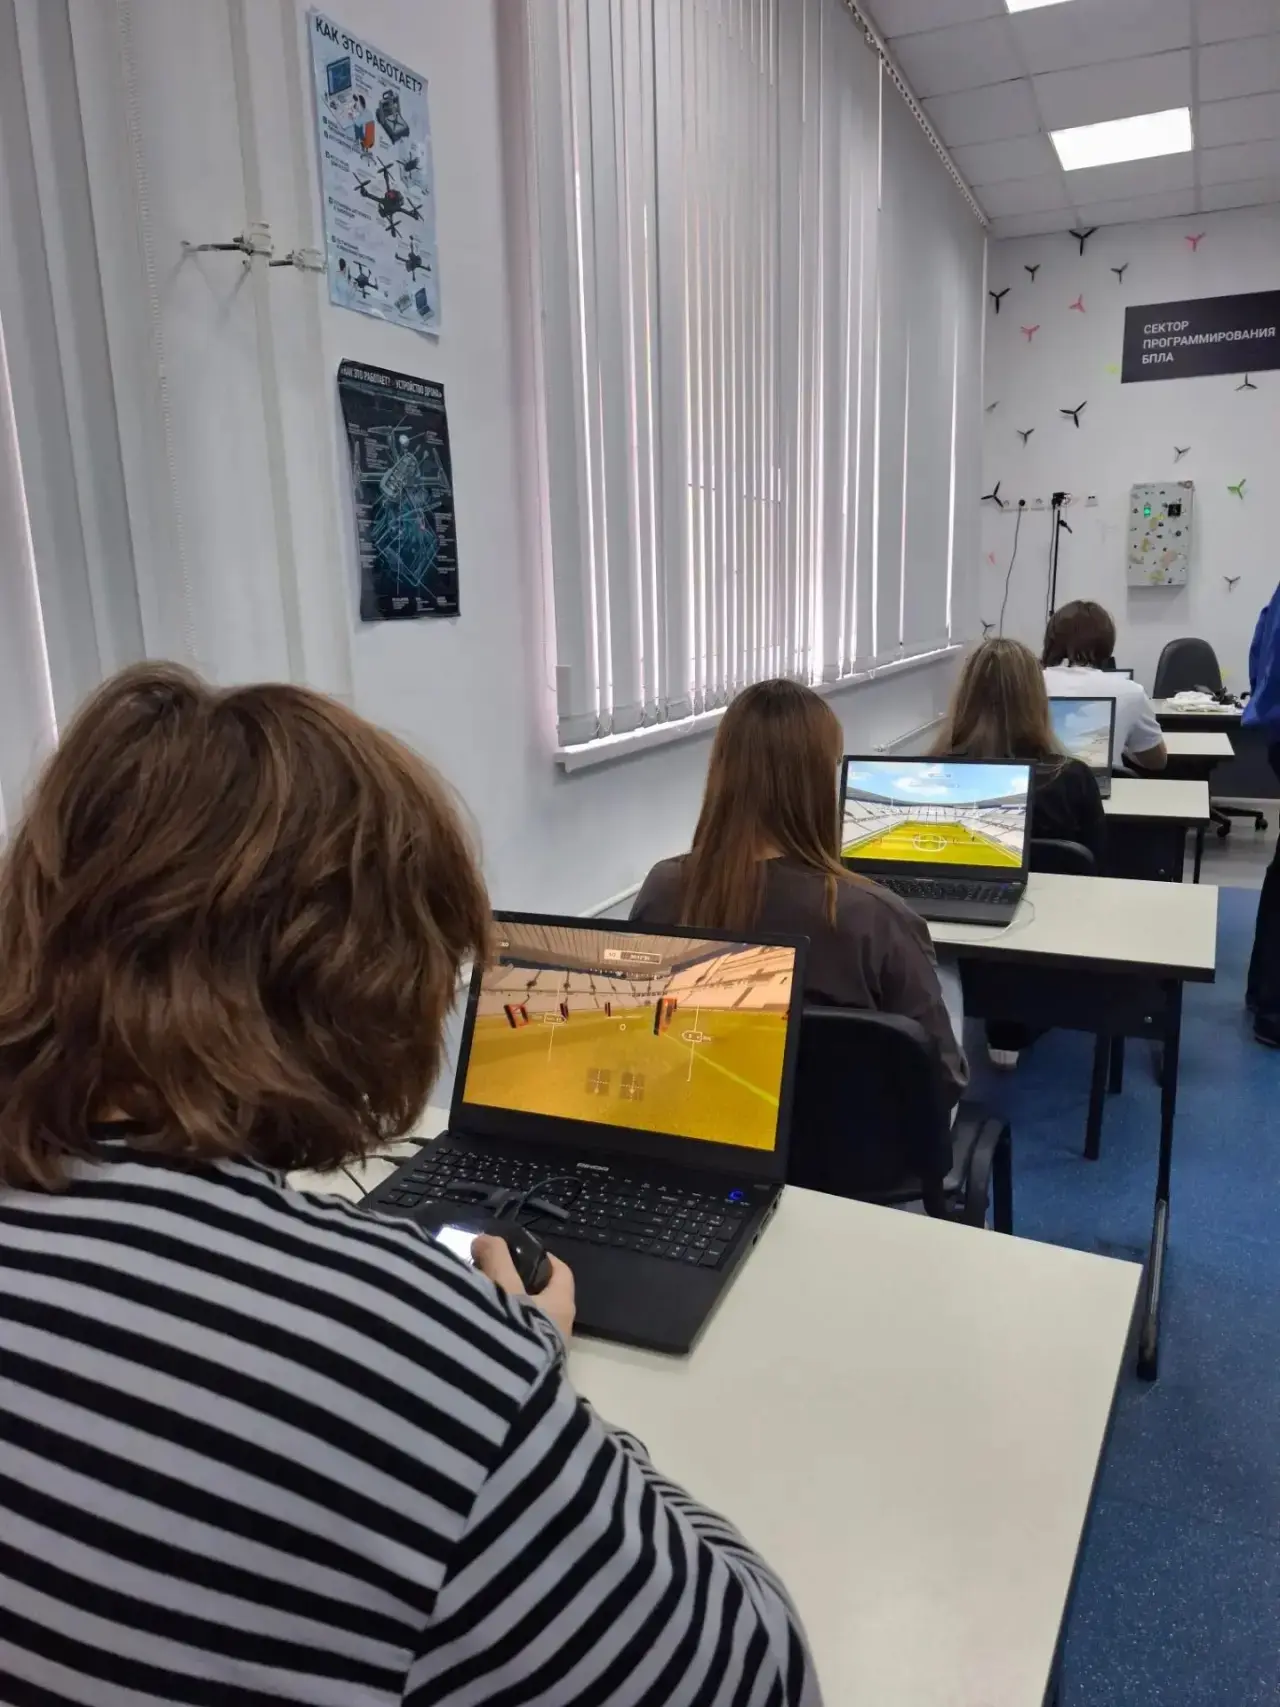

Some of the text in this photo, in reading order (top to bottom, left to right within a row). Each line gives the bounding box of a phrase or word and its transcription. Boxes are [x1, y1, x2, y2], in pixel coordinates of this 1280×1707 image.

[316, 16, 339, 44] КАК
[342, 34, 363, 59] ЭТО
[365, 50, 423, 96] РАБОТАЕТ?
[1144, 320, 1189, 334] СЕКТОР
[1142, 327, 1276, 349] ПРОГРАММИРОВАНИЯ
[1142, 352, 1174, 364] БПЛА
